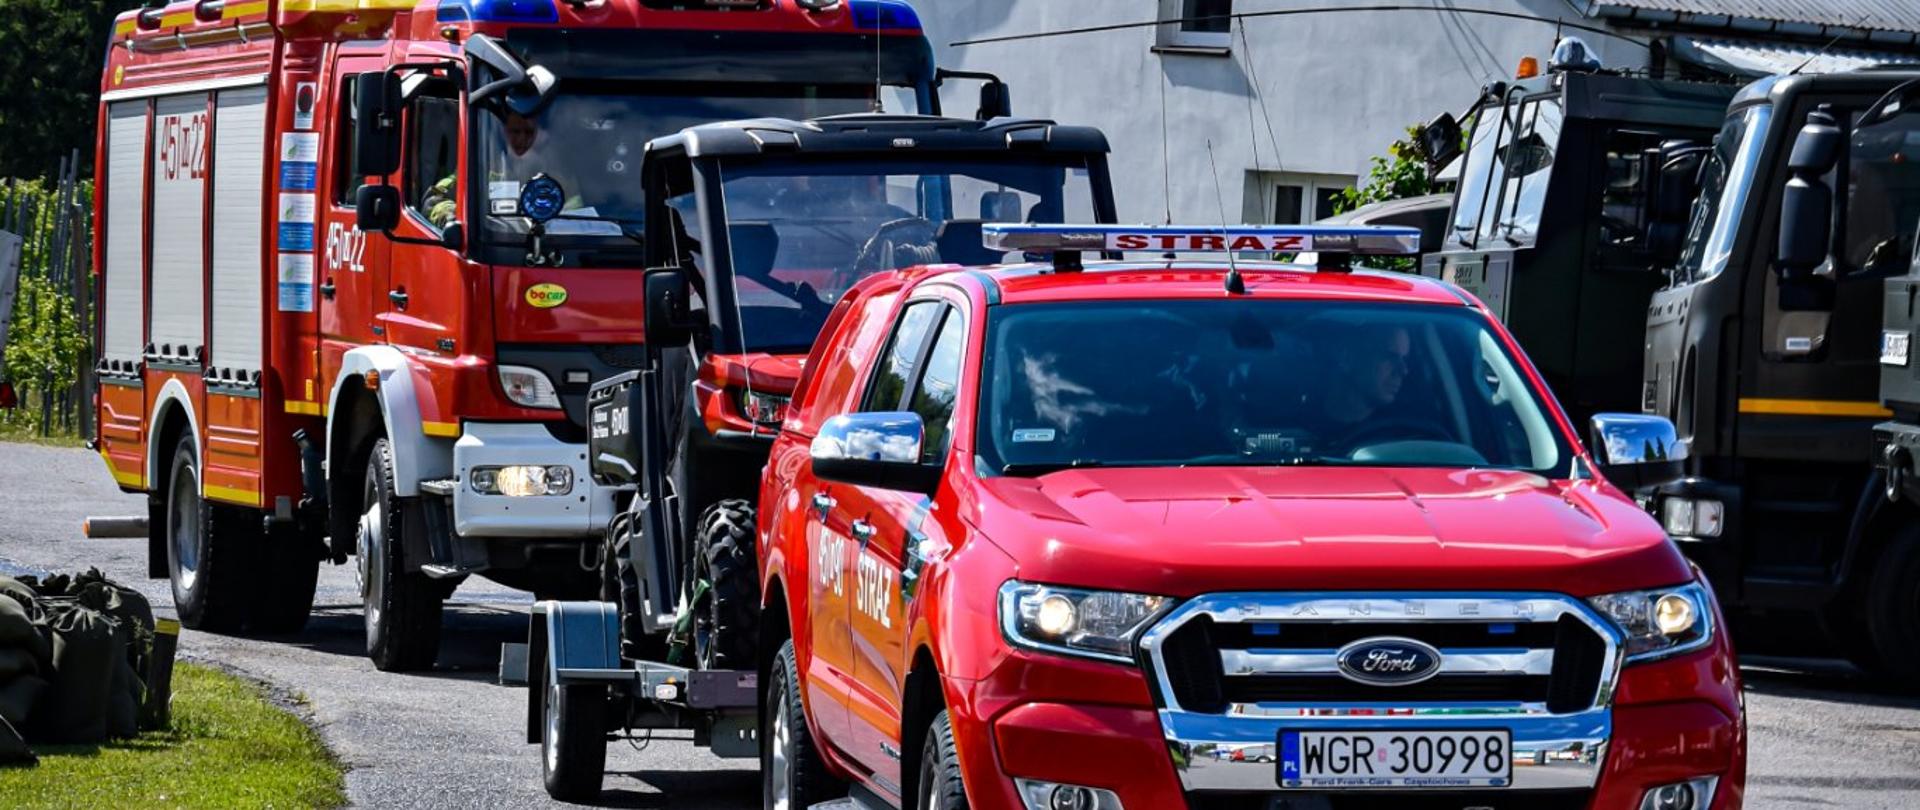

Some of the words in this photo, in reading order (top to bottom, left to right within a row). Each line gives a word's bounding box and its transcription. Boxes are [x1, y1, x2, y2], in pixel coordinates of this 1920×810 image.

[530, 290, 566, 300] bocar
[1362, 650, 1417, 672] Ford
[1303, 736, 1375, 774] WGR
[1389, 735, 1504, 774] 30998
[1284, 761, 1297, 772] PL
